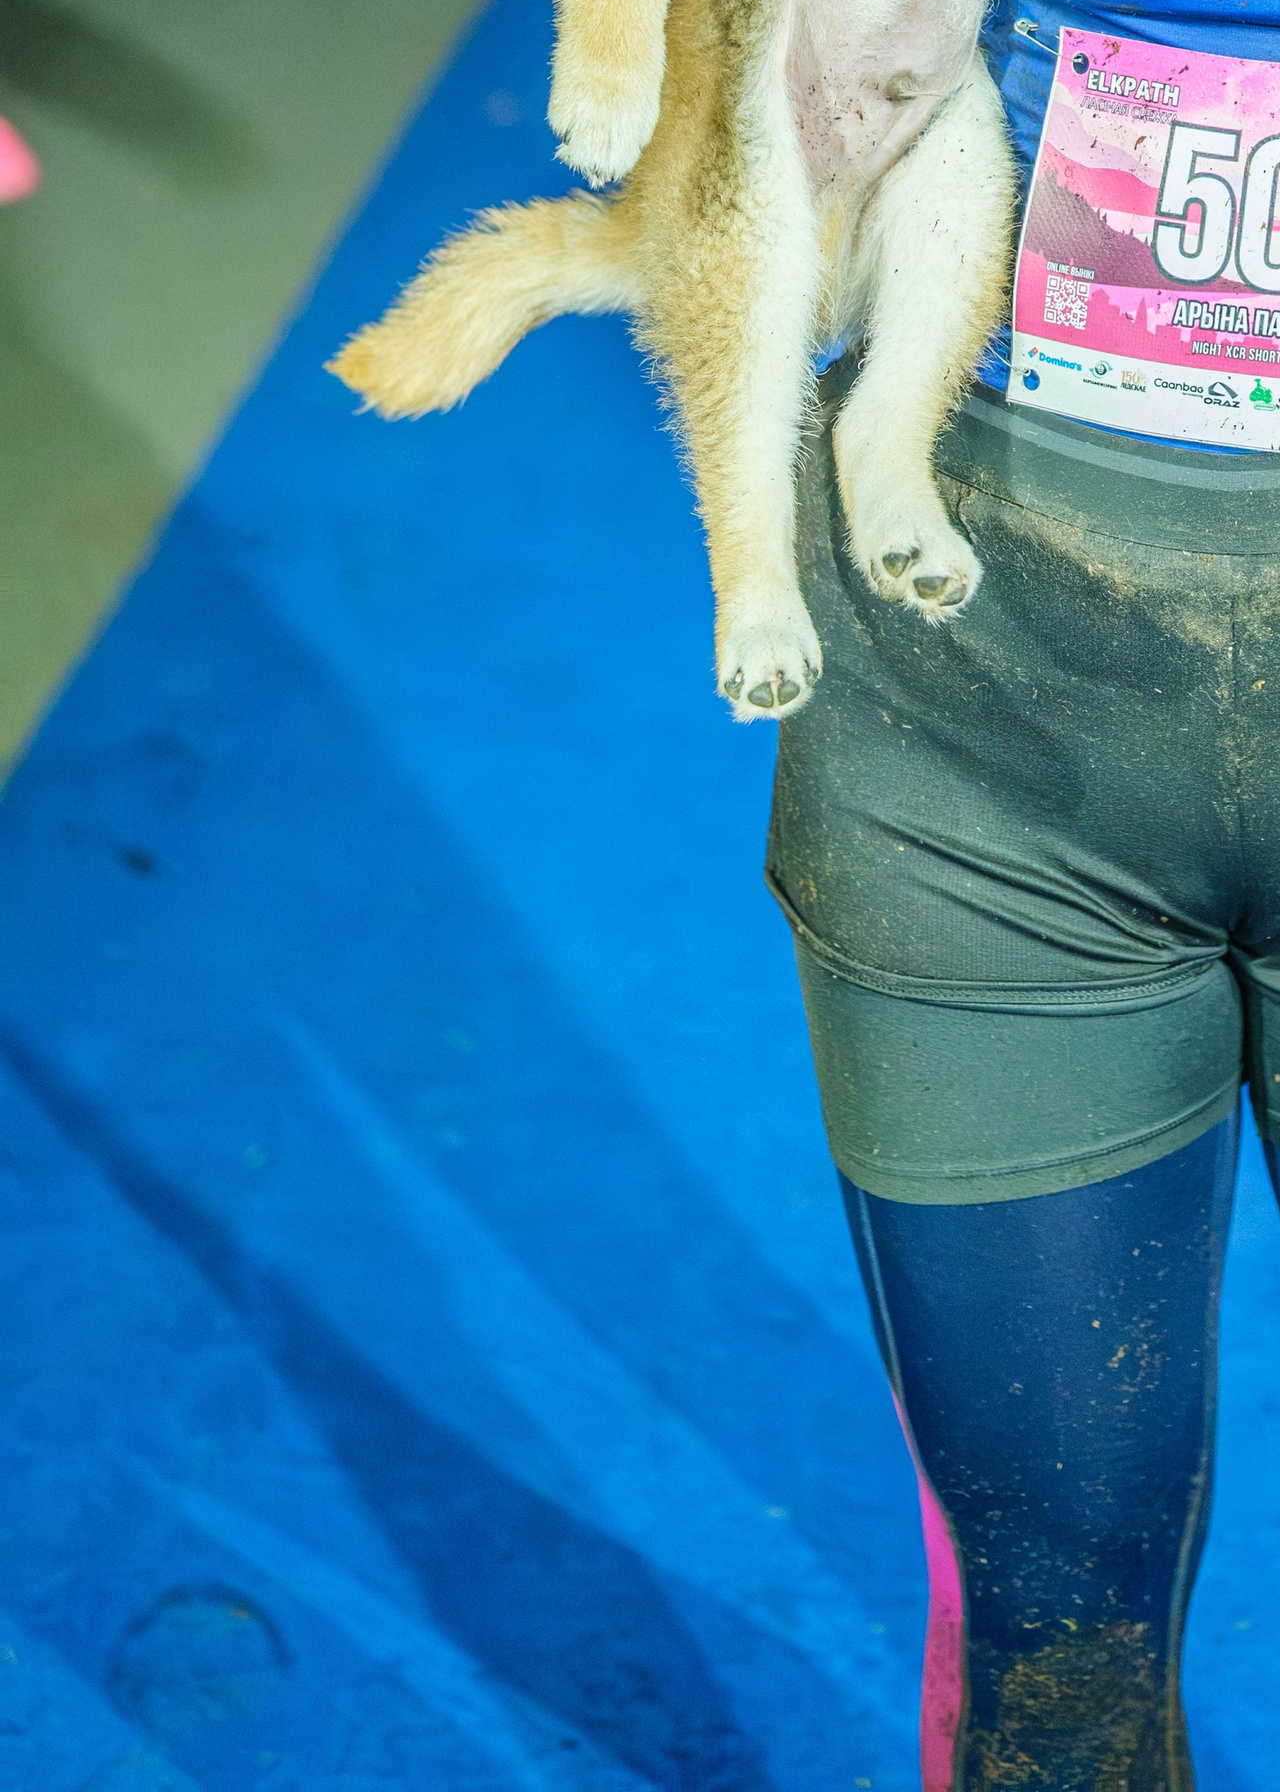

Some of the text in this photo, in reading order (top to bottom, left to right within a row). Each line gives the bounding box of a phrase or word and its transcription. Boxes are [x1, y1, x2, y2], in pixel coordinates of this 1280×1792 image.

[1086, 68, 1180, 107] ELKPATH
[1047, 261, 1070, 275] ONLINE
[1173, 299, 1249, 335] АРЫНА
[1192, 341, 1222, 357] NIGHT
[1225, 345, 1246, 360] XCR
[1038, 352, 1083, 372] Domino's
[1203, 397, 1241, 408] ORAZ
